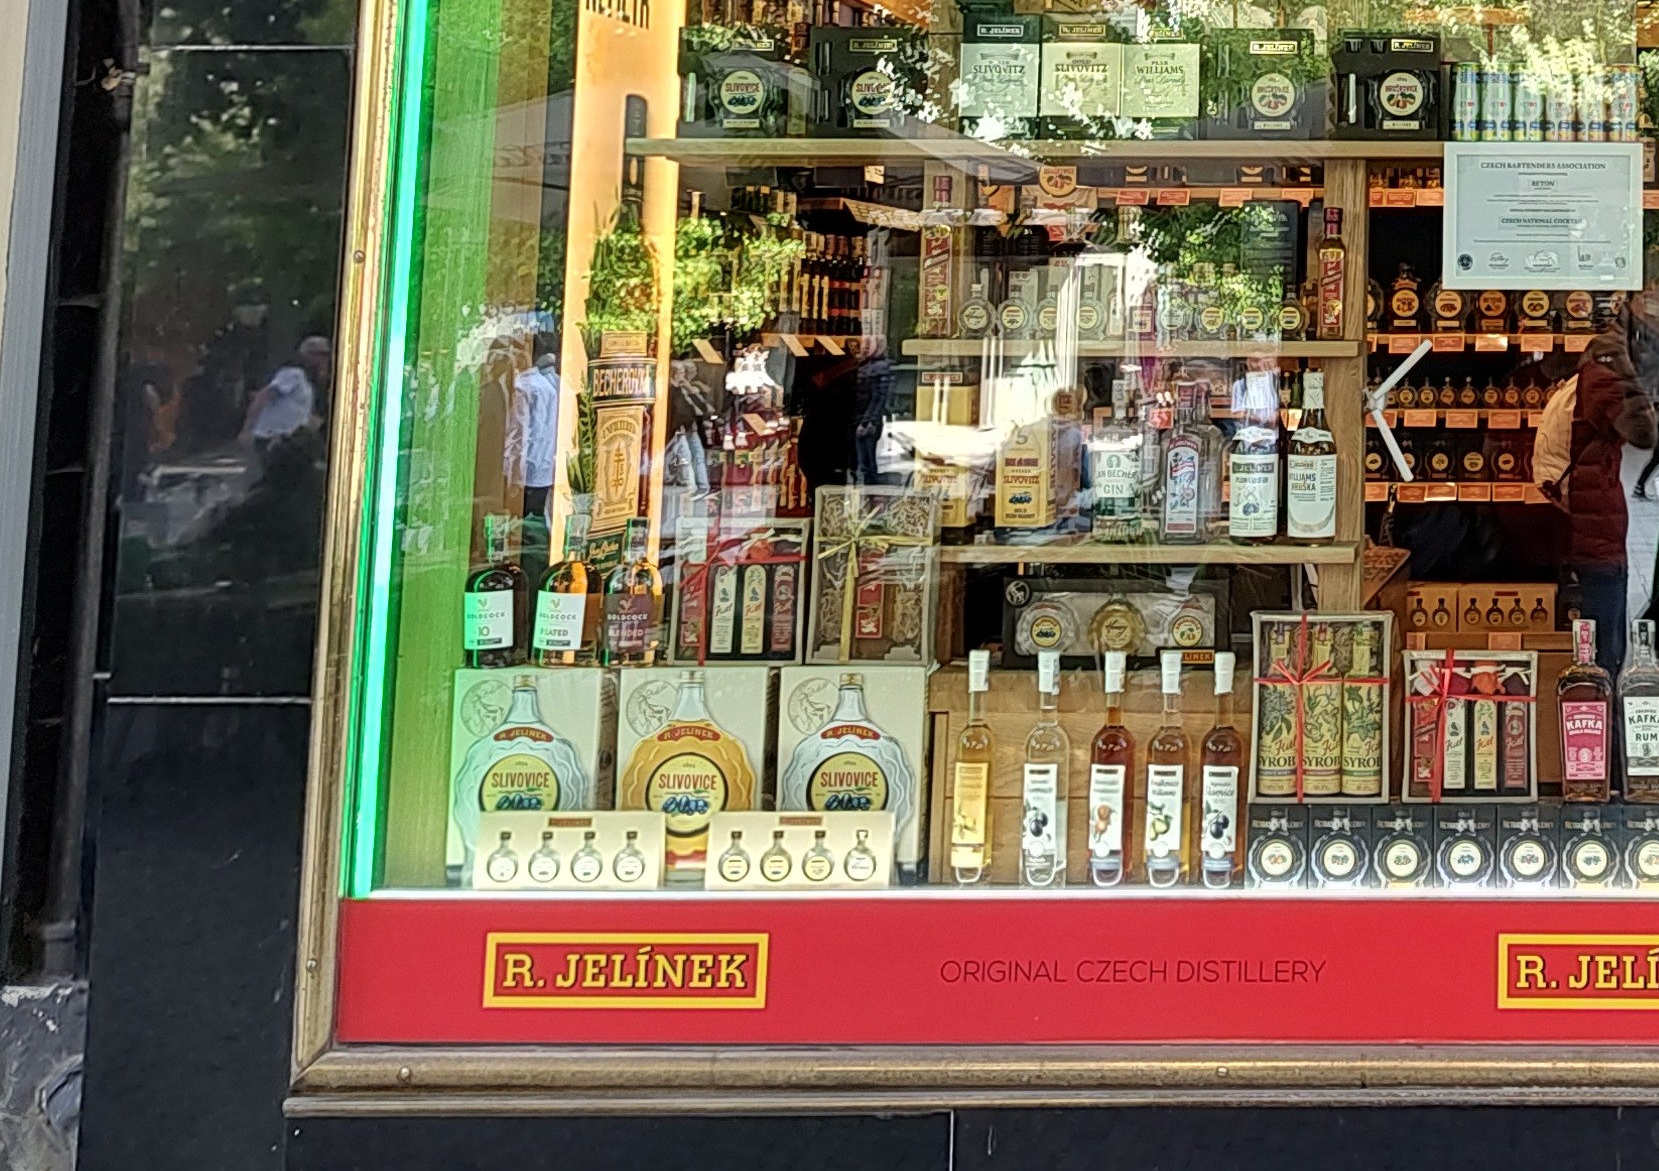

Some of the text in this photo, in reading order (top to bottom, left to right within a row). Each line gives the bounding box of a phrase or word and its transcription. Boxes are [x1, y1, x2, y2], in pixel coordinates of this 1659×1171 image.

[973, 64, 1025, 74] SLIVOVITZ
[1055, 63, 1108, 73] SLIVOVITZ
[1137, 65, 1184, 75] WILLIAMS
[1557, 162, 1606, 170] ASSOCIATION
[1103, 484, 1124, 495] GIN
[1566, 719, 1603, 731] KAFKA
[1635, 733, 1658, 742] RUM
[491, 772, 549, 789] SLIVOVICE
[659, 773, 717, 791] SLIVOVICE
[820, 773, 878, 789] SLIVOVICE
[503, 947, 749, 990] R. JELÍNEK
[940, 959, 1326, 984] ORIGINAL CZECH DISTILLERY
[1516, 955, 1559, 990] R.
